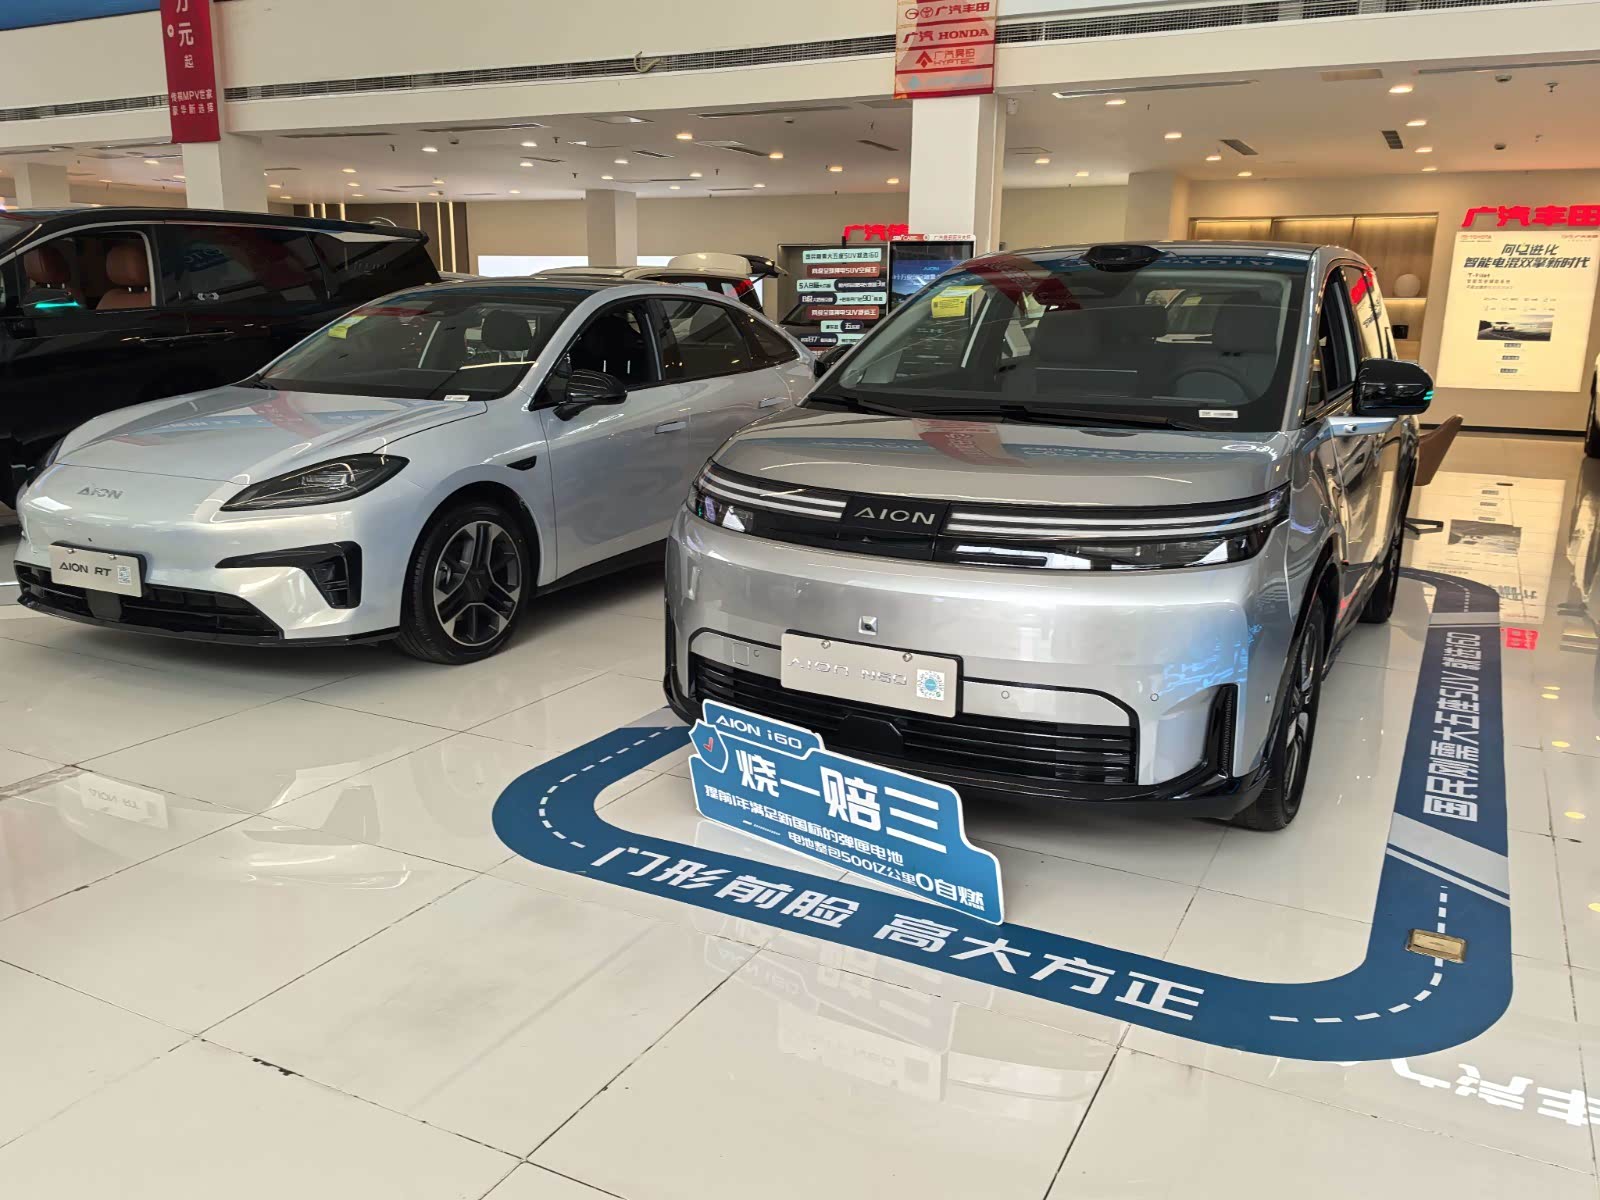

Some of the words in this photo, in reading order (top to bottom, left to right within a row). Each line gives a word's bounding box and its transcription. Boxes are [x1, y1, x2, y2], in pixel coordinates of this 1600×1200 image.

[935, 2, 990, 16] 广汽丰田
[903, 30, 934, 43] 广汽
[938, 28, 990, 40] HONDA
[1461, 205, 1600, 228] 广汽丰田
[1463, 256, 1590, 269] 智能电混双擎新时代
[78, 486, 124, 500] AION
[854, 507, 936, 525] AION
[59, 562, 88, 574] AION
[94, 567, 112, 577] RT
[716, 715, 761, 737] AION
[767, 729, 802, 749] i60
[1423, 671, 1480, 822] 国民刚需大五座SUV
[735, 749, 948, 854] 烧一赔三
[590, 847, 860, 928] 门形前脸
[873, 913, 1204, 1021] 高大方正
